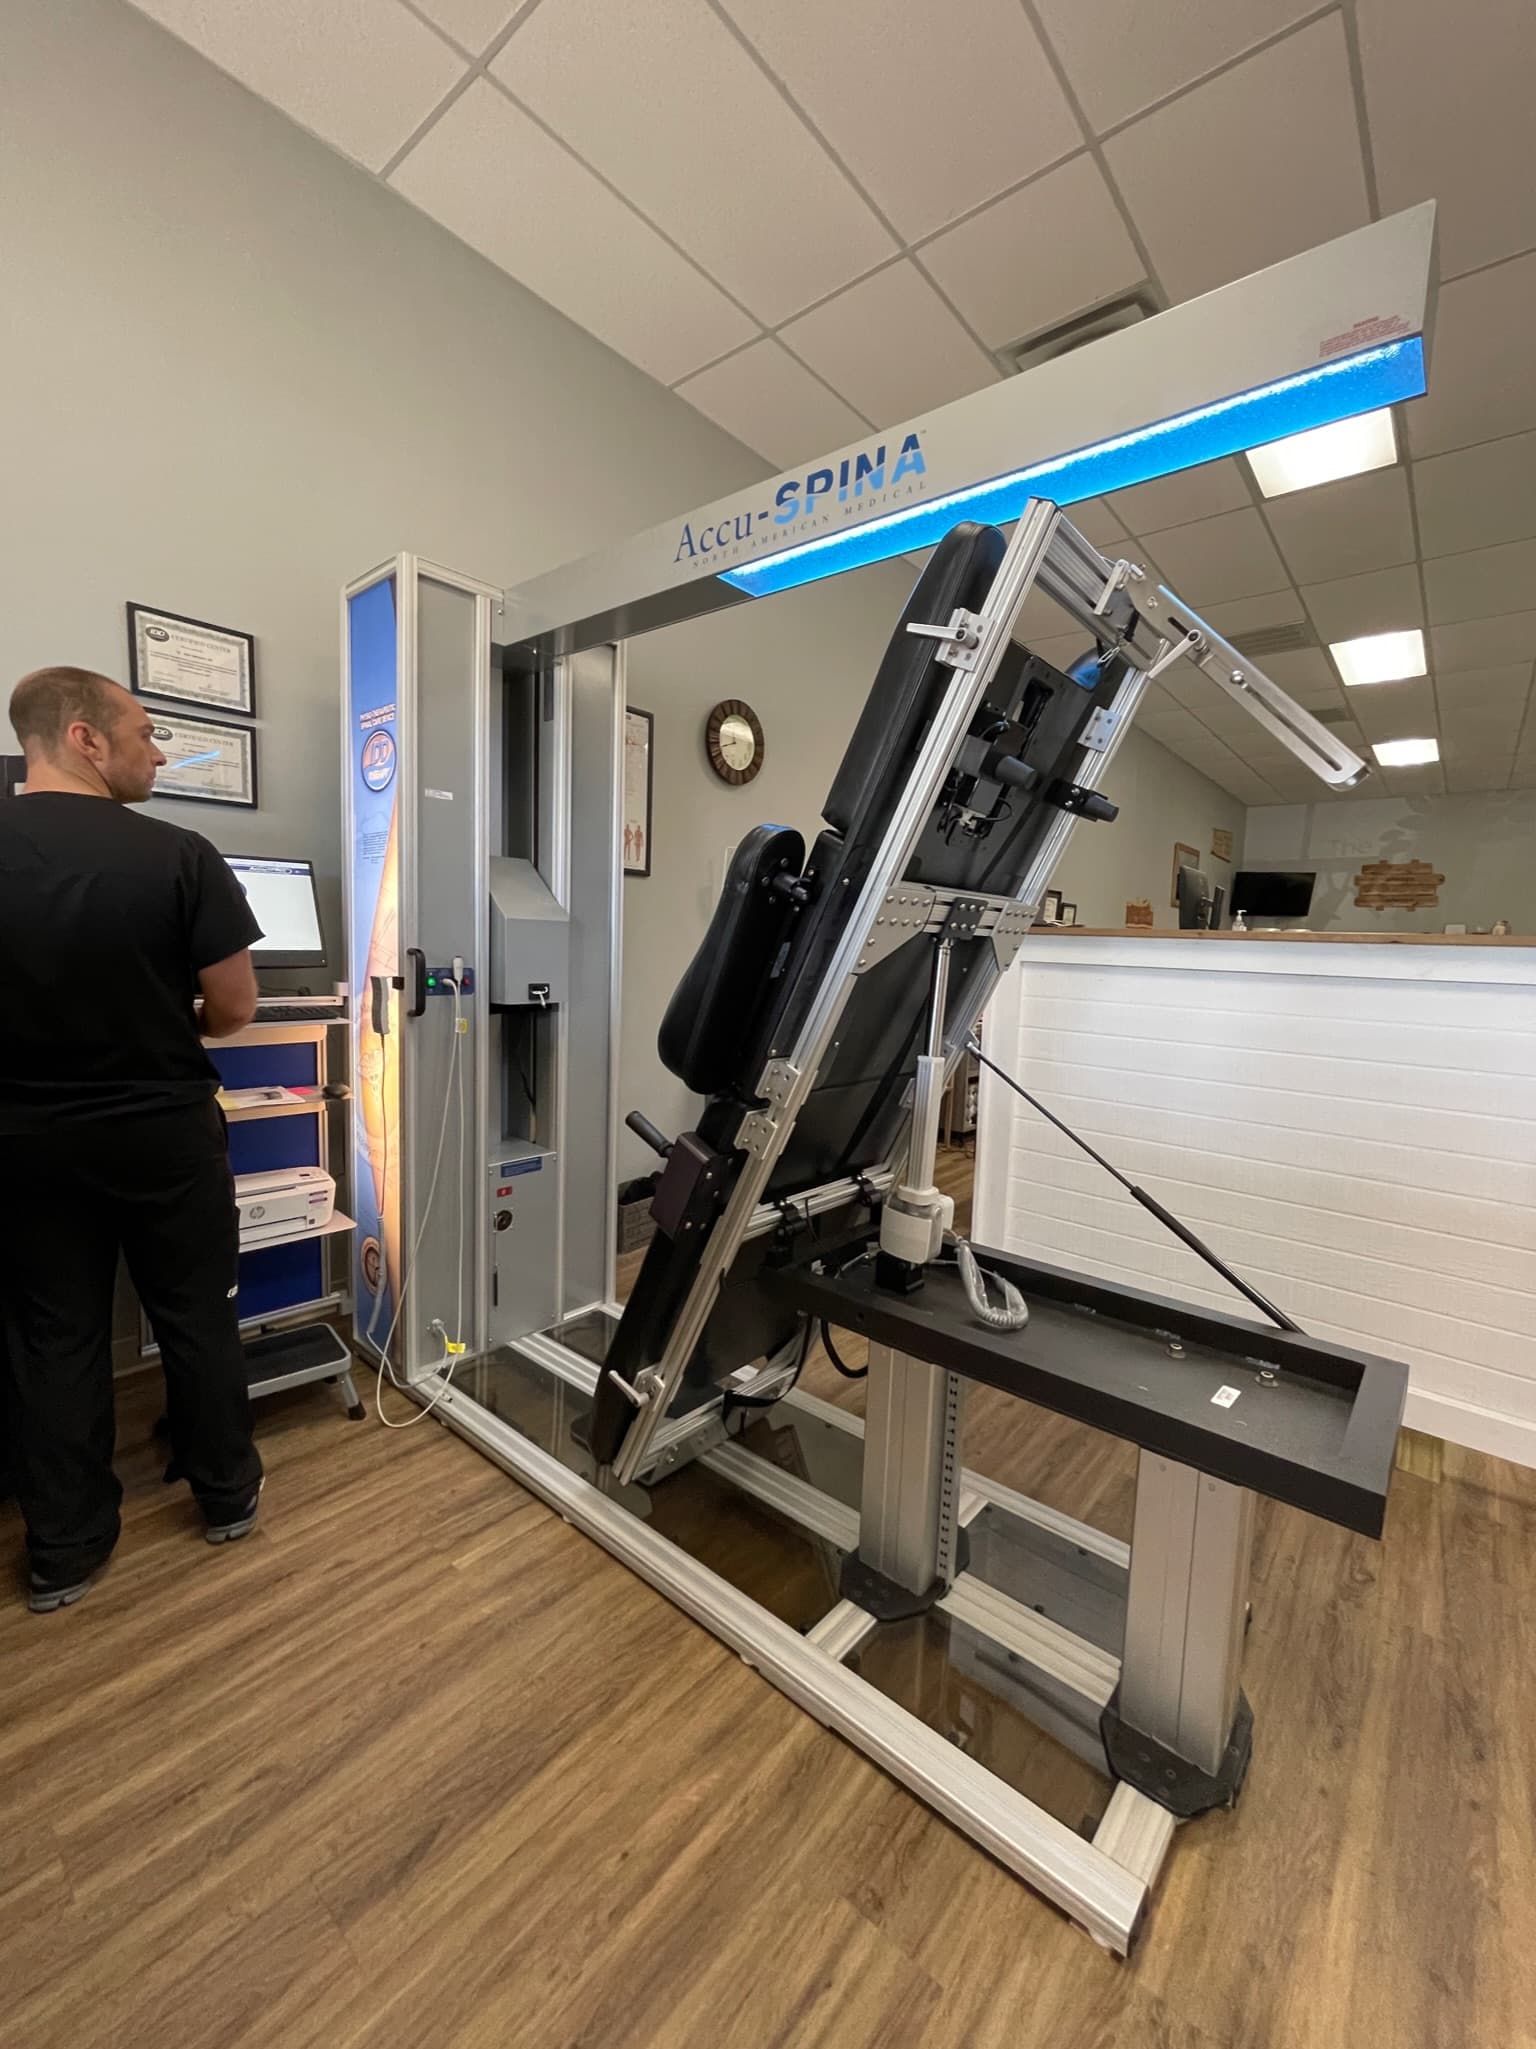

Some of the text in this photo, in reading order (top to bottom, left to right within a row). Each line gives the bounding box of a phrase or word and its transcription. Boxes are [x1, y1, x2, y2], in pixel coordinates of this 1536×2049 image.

[693, 481, 927, 568] NORTH AMERICAN MEDICAL
